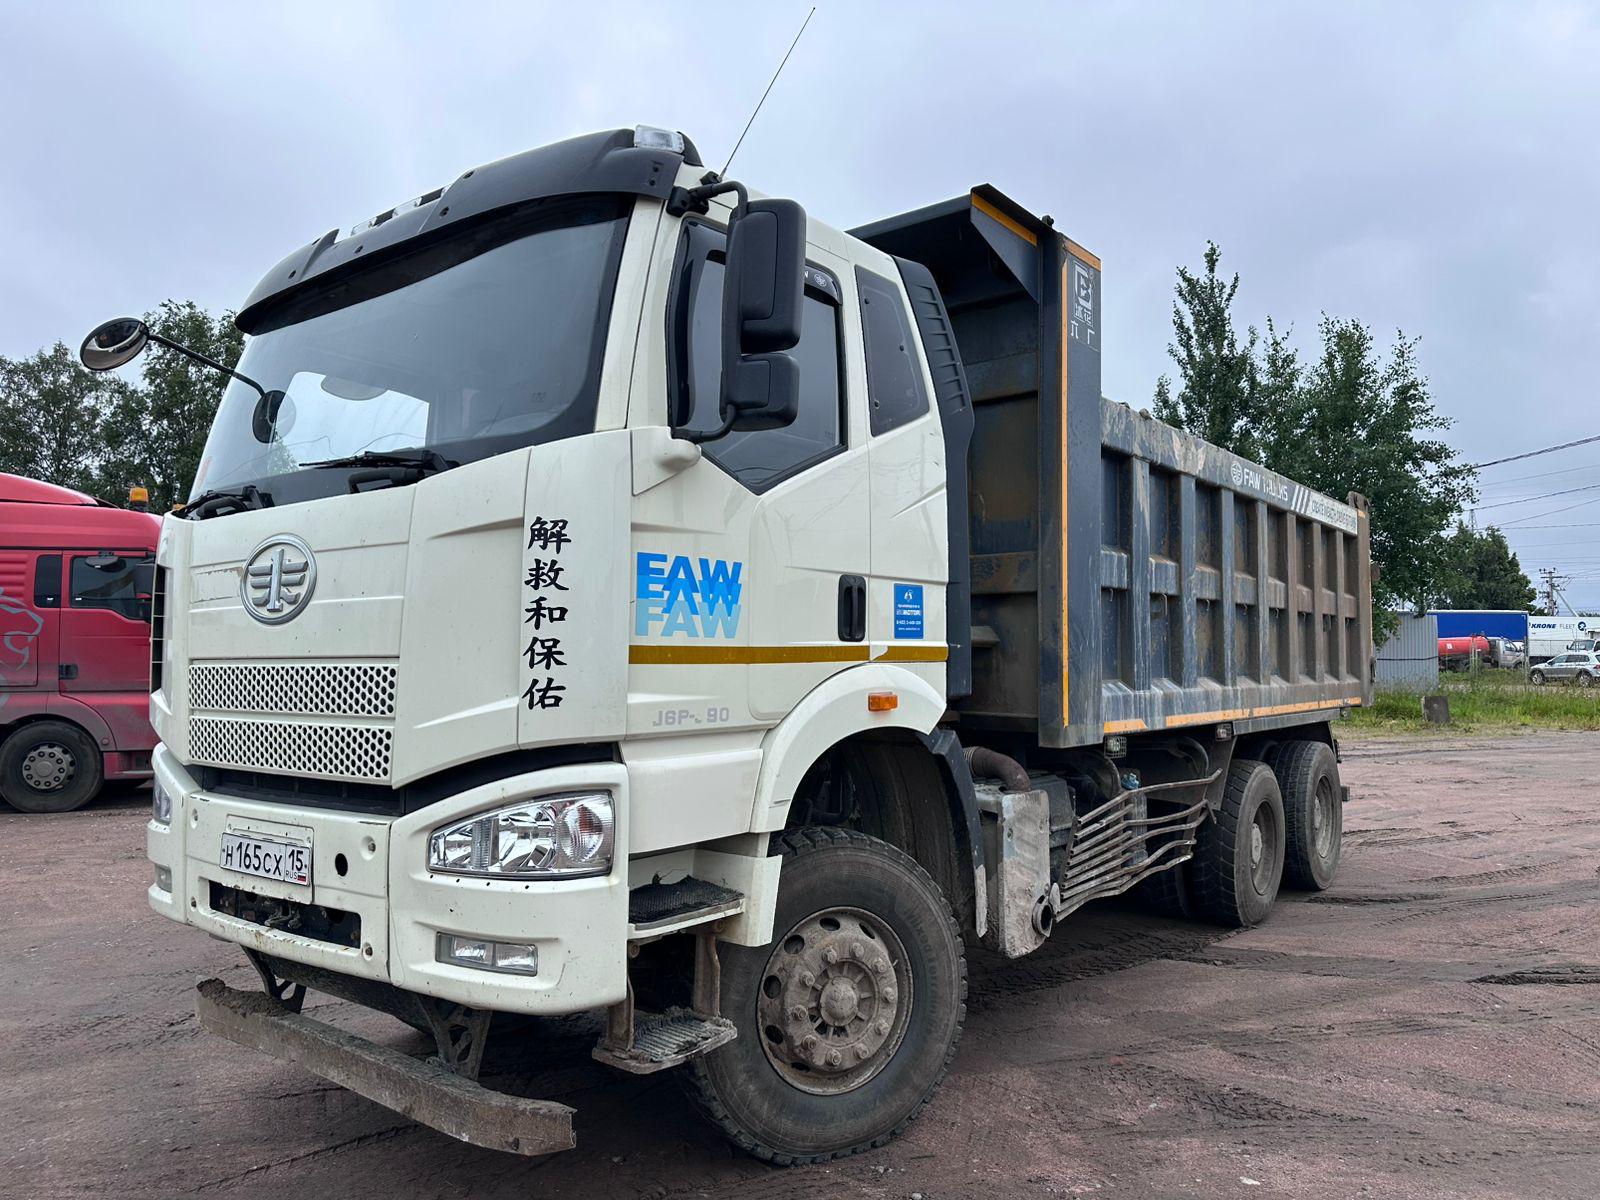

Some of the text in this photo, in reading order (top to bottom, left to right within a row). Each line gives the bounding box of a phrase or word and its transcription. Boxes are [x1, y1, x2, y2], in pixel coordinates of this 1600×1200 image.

[1243, 467, 1260, 490] FAW
[522, 516, 572, 710] 解救和保佑
[635, 598, 742, 639] FAW
[288, 849, 304, 871] 15
[285, 870, 297, 880] RUS
